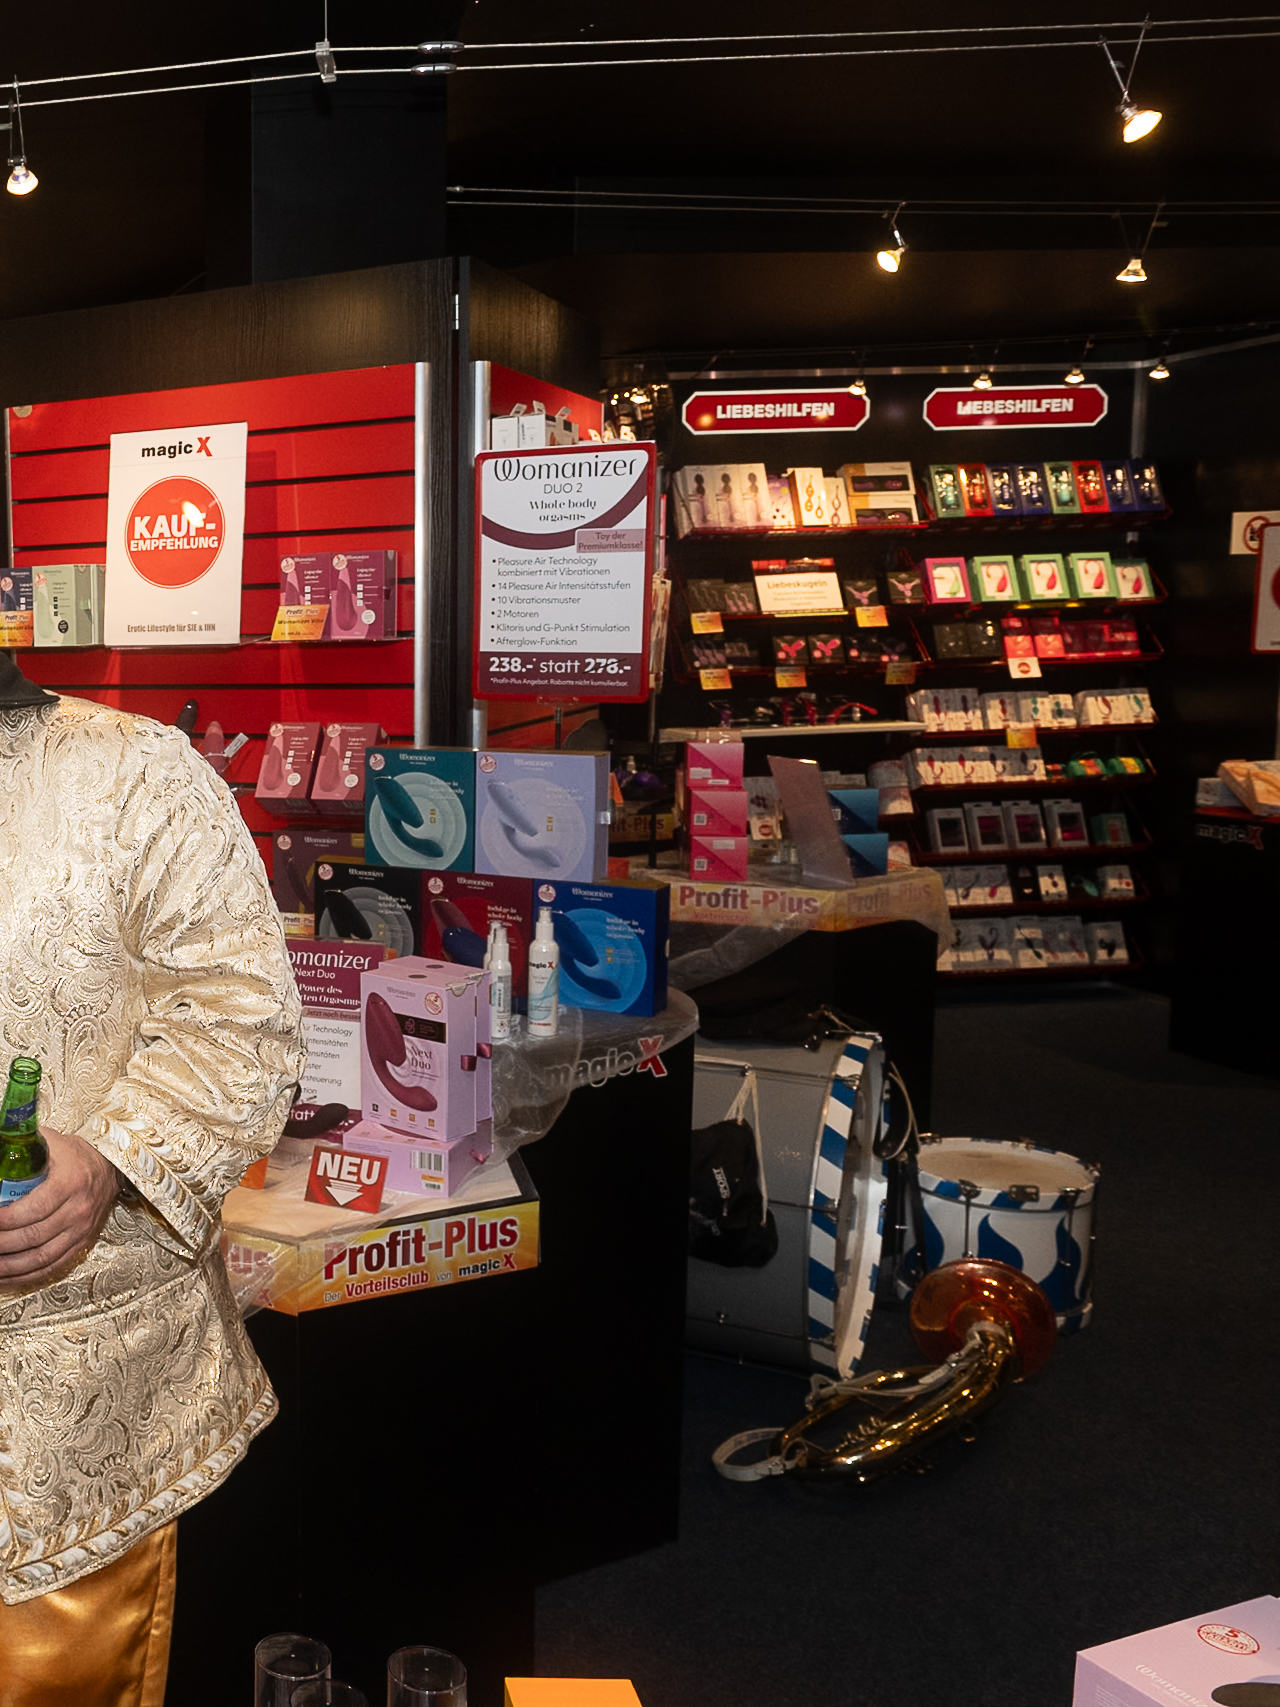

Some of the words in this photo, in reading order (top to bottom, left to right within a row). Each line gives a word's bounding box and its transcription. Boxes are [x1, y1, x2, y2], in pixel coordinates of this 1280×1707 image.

[716, 402, 835, 419] LIEBESHILFEN
[956, 398, 1074, 415] LIEBESHILFEN
[142, 441, 193, 458] magic
[196, 436, 213, 457] X
[494, 455, 637, 481] Womanizer
[544, 483, 572, 494] DUO
[576, 482, 583, 493] 2
[530, 500, 566, 510] Whole
[569, 498, 597, 509] body
[539, 513, 586, 523] orgasms
[595, 532, 610, 541] Toy
[612, 531, 626, 540] der
[130, 535, 218, 552] EMPFEHLUNG
[578, 541, 643, 551] Premiumklasse!
[498, 557, 533, 566] Pleasure
[534, 557, 546, 565] Air
[548, 556, 598, 567] Technology
[498, 568, 542, 576] kombiniert
[544, 568, 557, 576] mit
[559, 567, 610, 576] Vibrationen
[498, 582, 507, 590] 14
[509, 582, 544, 590] Pleasure
[545, 582, 558, 590] Air
[559, 580, 631, 590] Intensitätsstufen
[498, 596, 508, 604] 10
[509, 595, 581, 604] Vibrationsmuster
[497, 610, 502, 618] 2
[504, 609, 539, 618] Motoren
[496, 623, 524, 632] Klitoris
[526, 624, 541, 632] und
[543, 623, 579, 632] G-Punkt
[580, 623, 630, 632] Stimulation
[496, 637, 577, 647] Afterglow-Funktion
[539, 659, 580, 673] statt
[399, 753, 436, 762] Womanizer
[304, 836, 338, 844] Womanizer
[348, 868, 384, 877] Womanizer
[457, 877, 494, 887] Womanizer
[572, 887, 613, 898] Womanizer
[678, 885, 820, 914] Profit-Plus
[287, 949, 372, 970] omanizer
[294, 967, 316, 977] Next
[317, 969, 336, 979] Duo
[299, 983, 325, 993] Power
[327, 986, 343, 994] des
[313, 1024, 353, 1036] Technology
[411, 1045, 433, 1059] Next
[636, 1034, 668, 1078] X
[411, 1057, 431, 1070] Duo
[316, 1152, 381, 1186] NEU
[323, 1217, 519, 1280] Profit-Plus
[324, 1291, 342, 1302] Der
[345, 1270, 429, 1298] Vorteilsclub
[436, 1271, 452, 1281] von
[458, 1259, 500, 1277] magic
[502, 1253, 516, 1269] X
